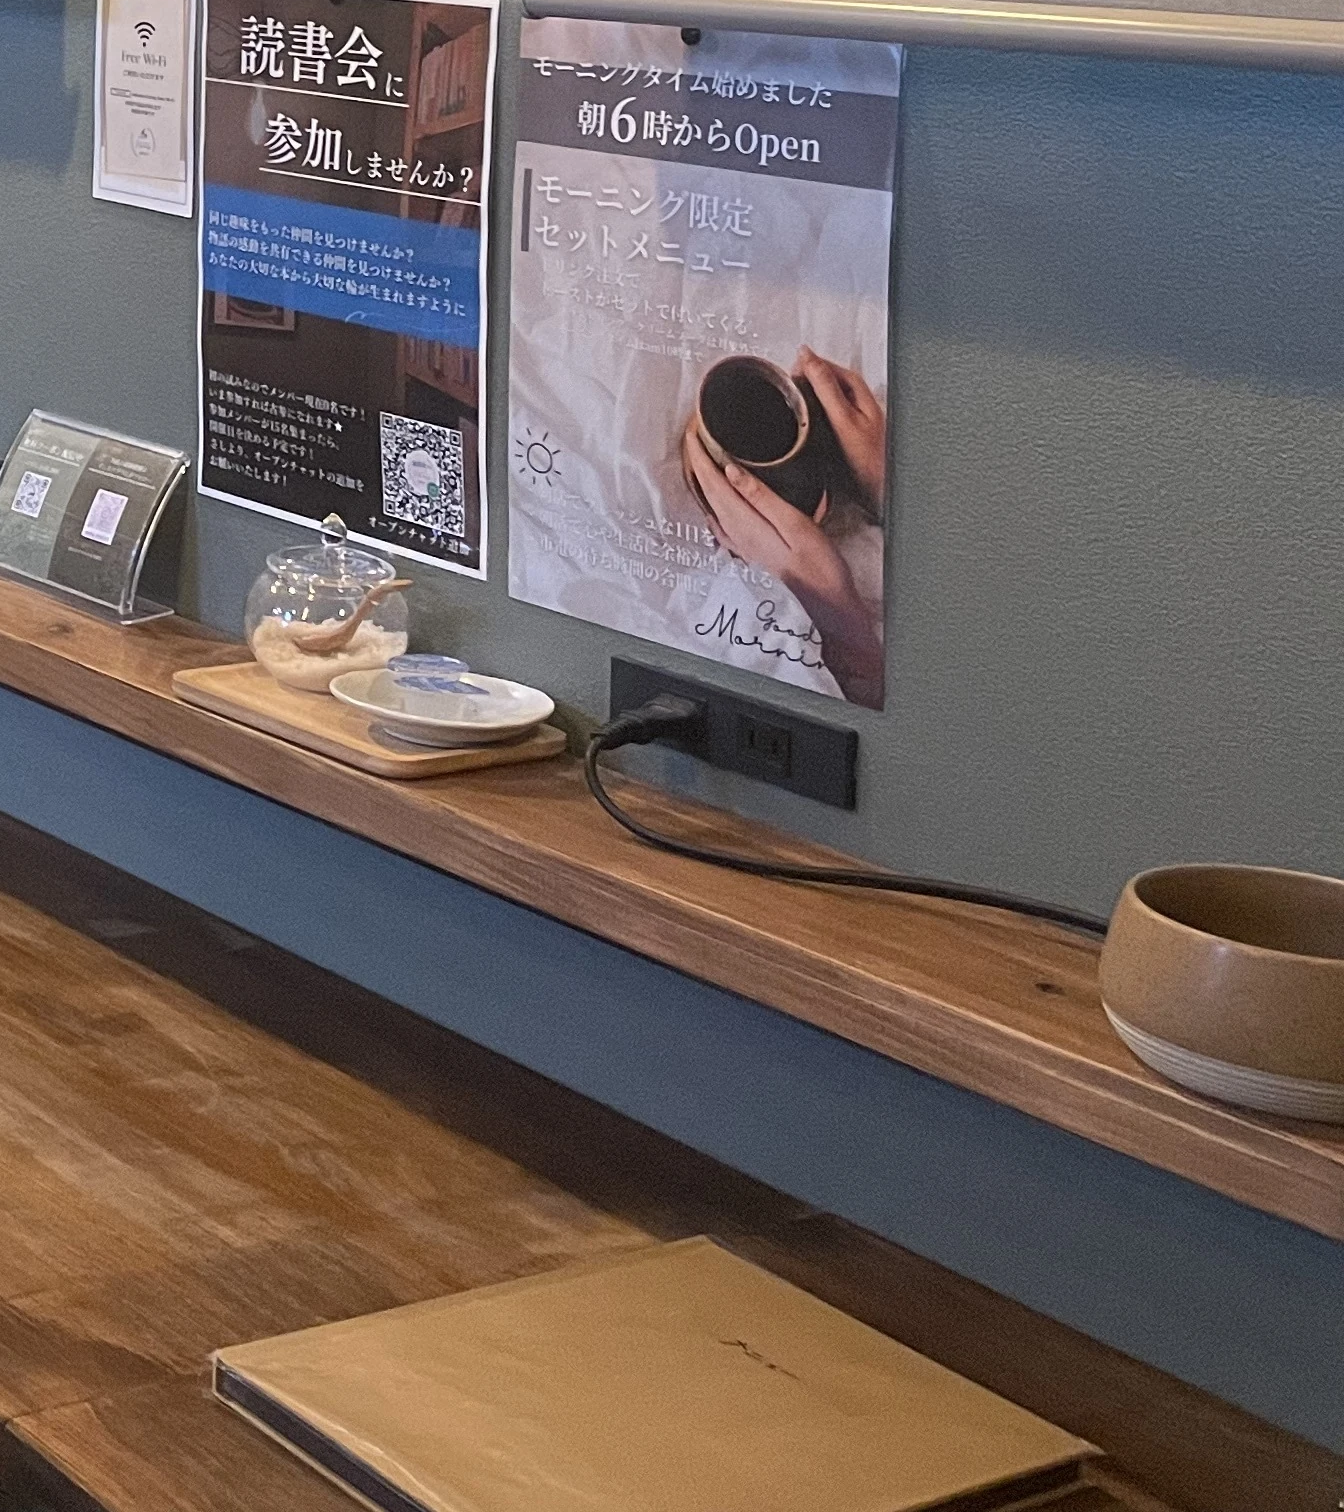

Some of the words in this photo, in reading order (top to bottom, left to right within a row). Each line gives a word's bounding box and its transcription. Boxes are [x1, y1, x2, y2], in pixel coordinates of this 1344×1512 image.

[121, 50, 141, 64] Free
[143, 52, 167, 68] Wi-Fi
[240, 15, 404, 97] 読書会に
[533, 56, 832, 108] モーニングタイム始めました
[264, 113, 474, 192] 参加しませんか？
[536, 175, 754, 237] モーニング限定
[534, 216, 750, 272] セットメニュー
